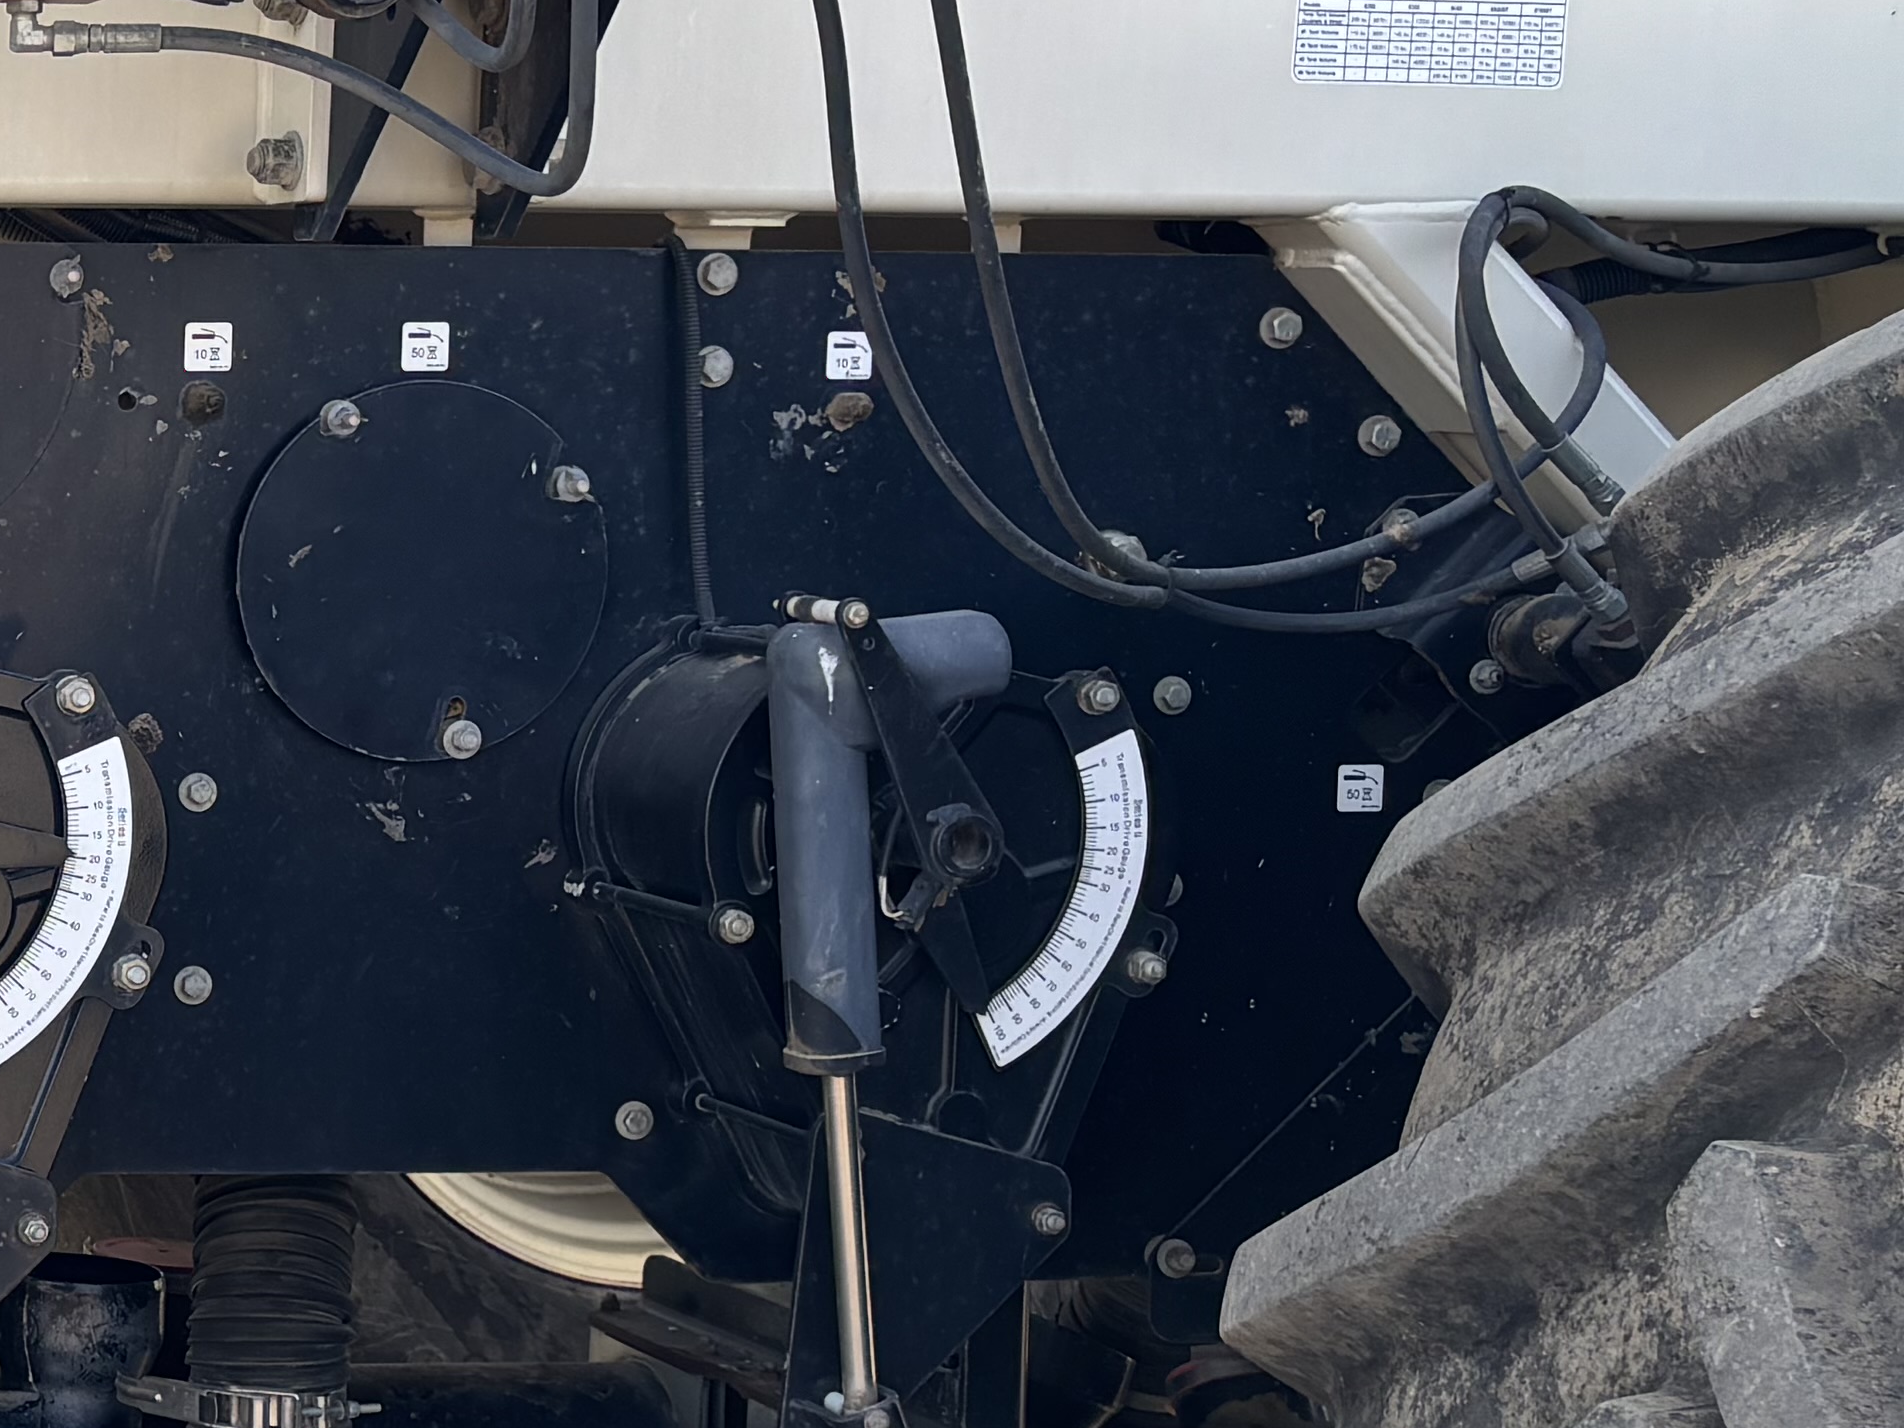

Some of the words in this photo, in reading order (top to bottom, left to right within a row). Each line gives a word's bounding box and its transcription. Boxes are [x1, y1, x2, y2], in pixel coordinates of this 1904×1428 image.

[194, 348, 208, 361] 10
[410, 346, 425, 359] 50
[836, 358, 848, 369] 10
[100, 759, 114, 827] Transmission
[1109, 793, 1120, 803] 10
[93, 800, 103, 810] 10
[1109, 822, 1120, 832] 15
[92, 831, 102, 840] 15
[106, 829, 115, 856] Drive
[1106, 846, 1118, 856] 20
[89, 855, 100, 864] 20
[100, 858, 113, 889] Gauge
[1099, 883, 1111, 894] 30
[80, 891, 92, 901] 30
[1088, 912, 1100, 923] 40
[68, 921, 81, 932] 40
[1075, 938, 1087, 950] 50
[54, 947, 68, 959] 50
[1045, 980, 1057, 993] 70
[24, 988, 36, 1001] 70
[993, 1024, 1006, 1041] 100
